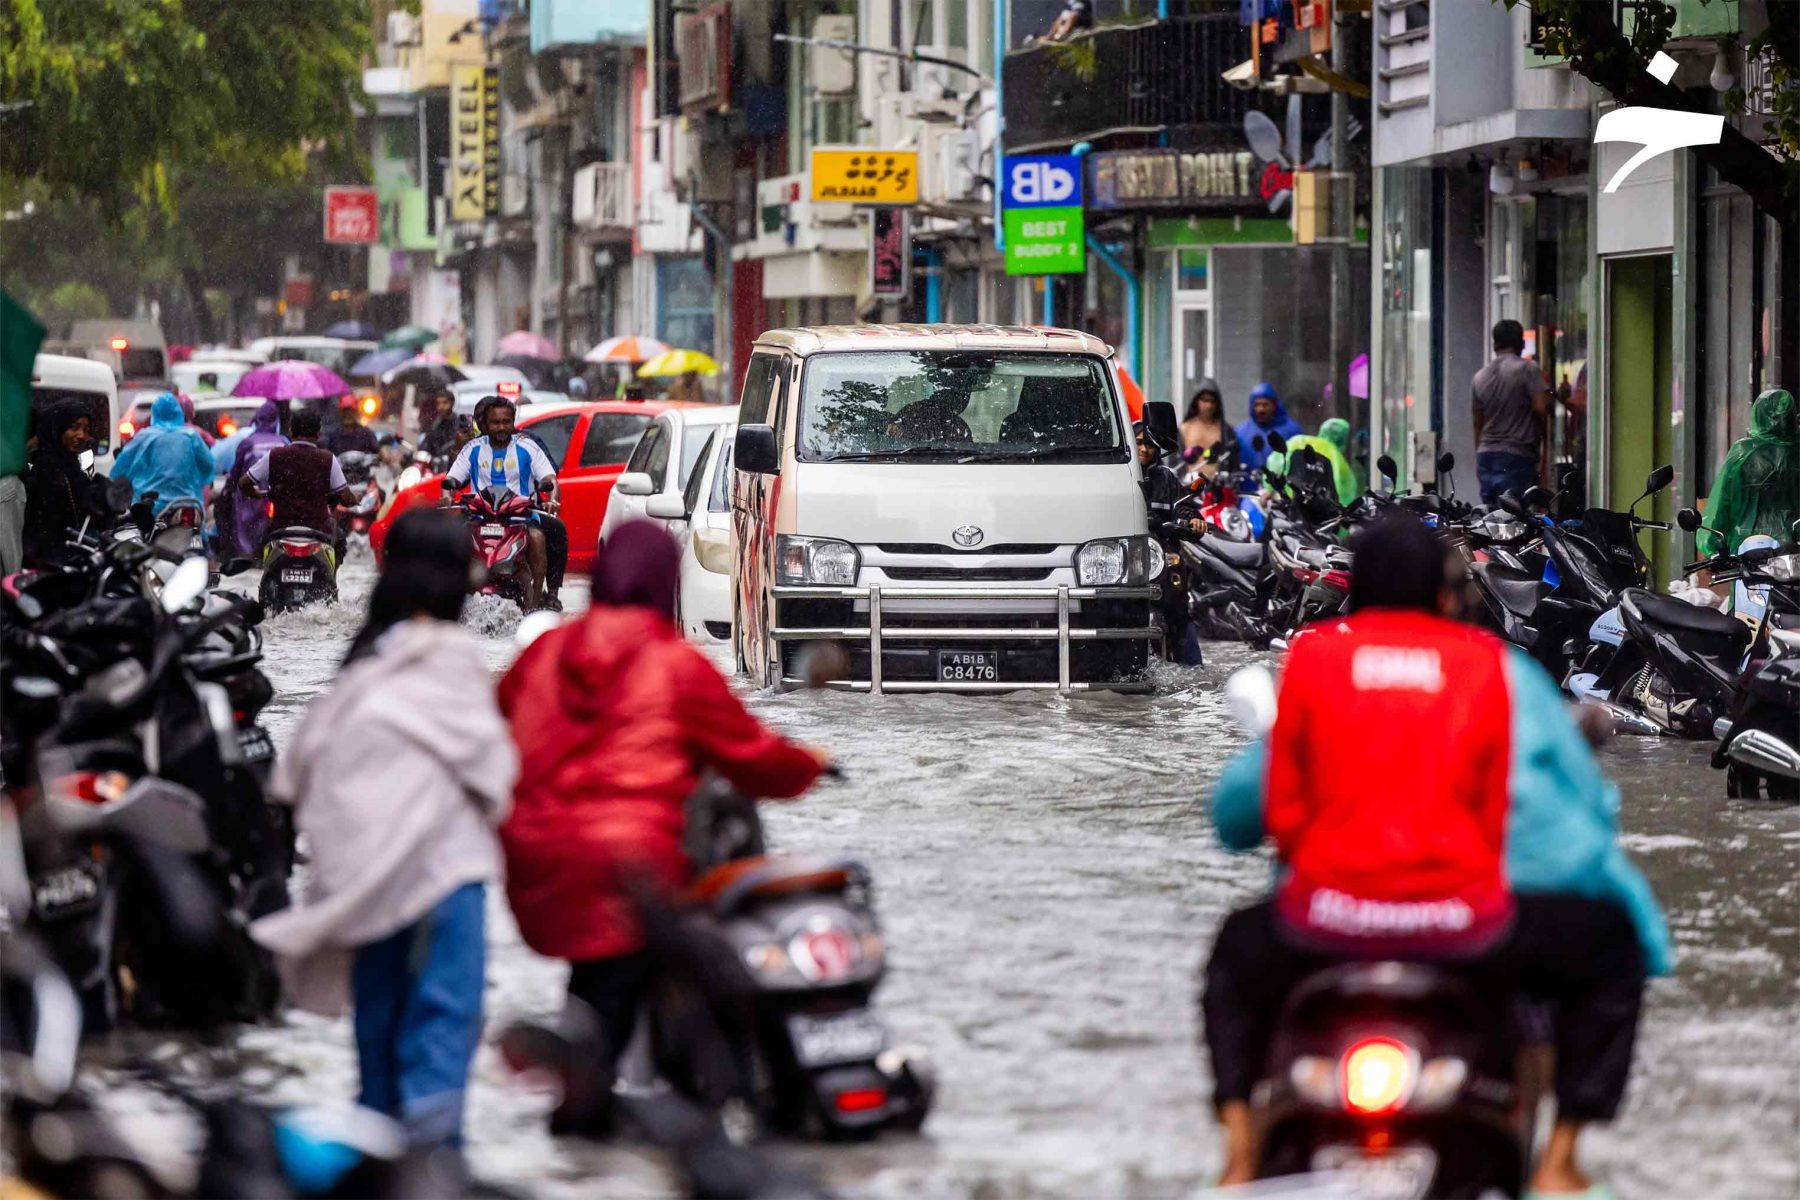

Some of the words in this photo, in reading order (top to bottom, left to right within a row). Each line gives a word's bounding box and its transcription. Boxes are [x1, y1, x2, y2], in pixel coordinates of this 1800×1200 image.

[1022, 221, 1067, 238] BEST
[1014, 243, 1062, 258] BUDDY
[953, 655, 984, 664] AB1B
[943, 666, 994, 679] C8476
